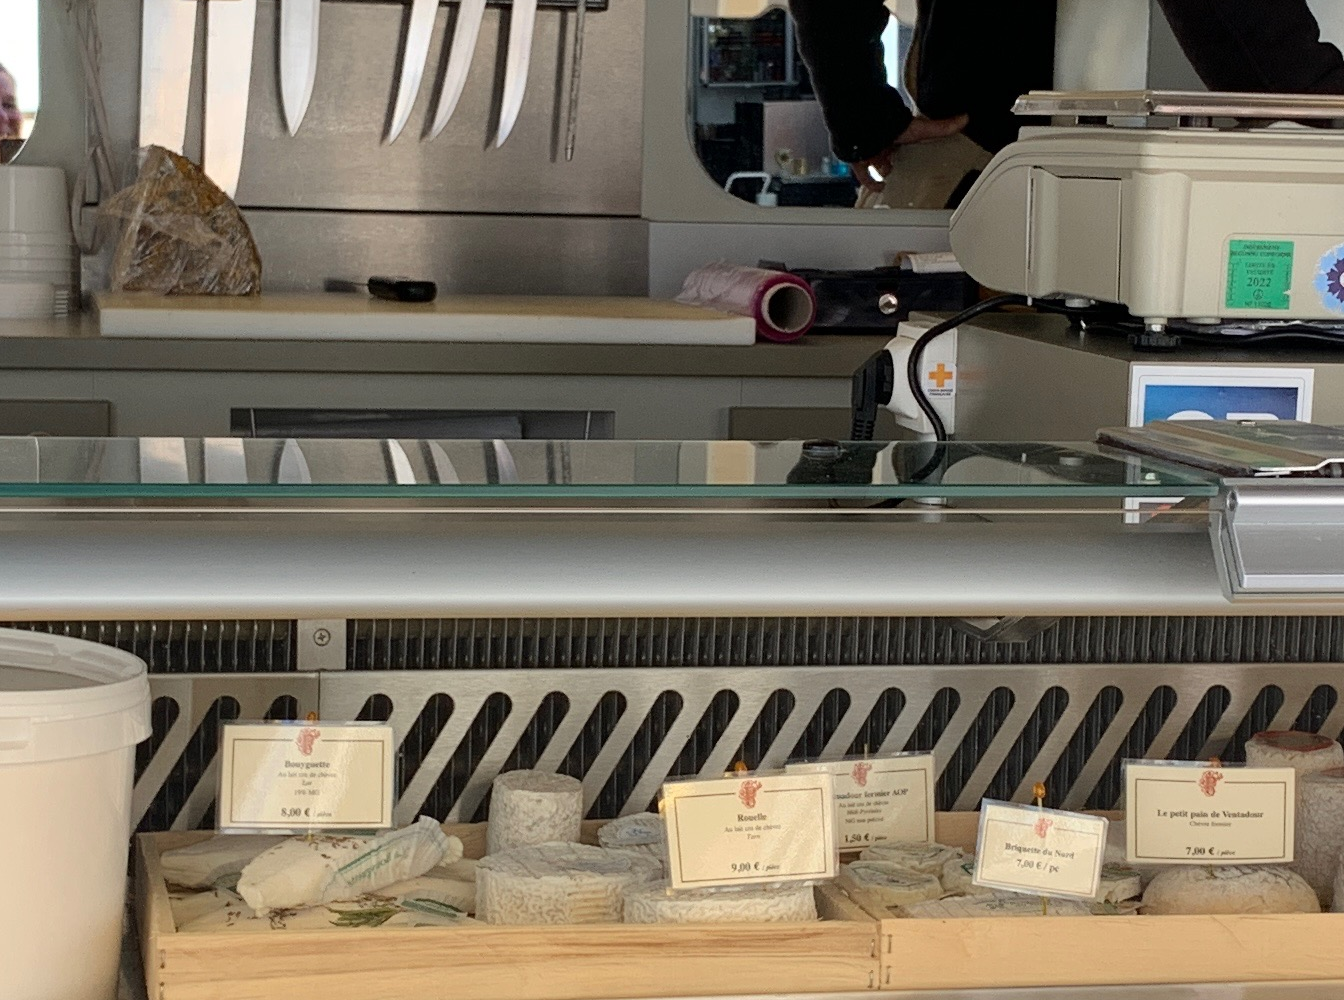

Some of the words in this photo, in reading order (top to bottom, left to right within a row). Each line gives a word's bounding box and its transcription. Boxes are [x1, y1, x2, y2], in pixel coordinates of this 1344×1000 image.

[1246, 277, 1271, 287] 2022
[284, 760, 330, 769] Bouyguette
[281, 807, 301, 818] 8,00
[304, 807, 311, 817] €
[1157, 809, 1168, 817] Le
[1170, 810, 1188, 819] petit
[1191, 811, 1207, 819] pain
[1211, 810, 1220, 818] de
[737, 814, 767, 822] Rouelle
[864, 833, 869, 841] €
[1005, 842, 1041, 854] Briquette
[1043, 848, 1053, 856] du
[1055, 850, 1074, 859] Nord
[1186, 847, 1205, 856] 7,00
[1209, 847, 1215, 855] €
[731, 862, 751, 872] 9,00
[754, 862, 760, 871] €
[1017, 859, 1034, 869] 7,00
[1036, 861, 1042, 869] €
[1049, 865, 1059, 873] pc
